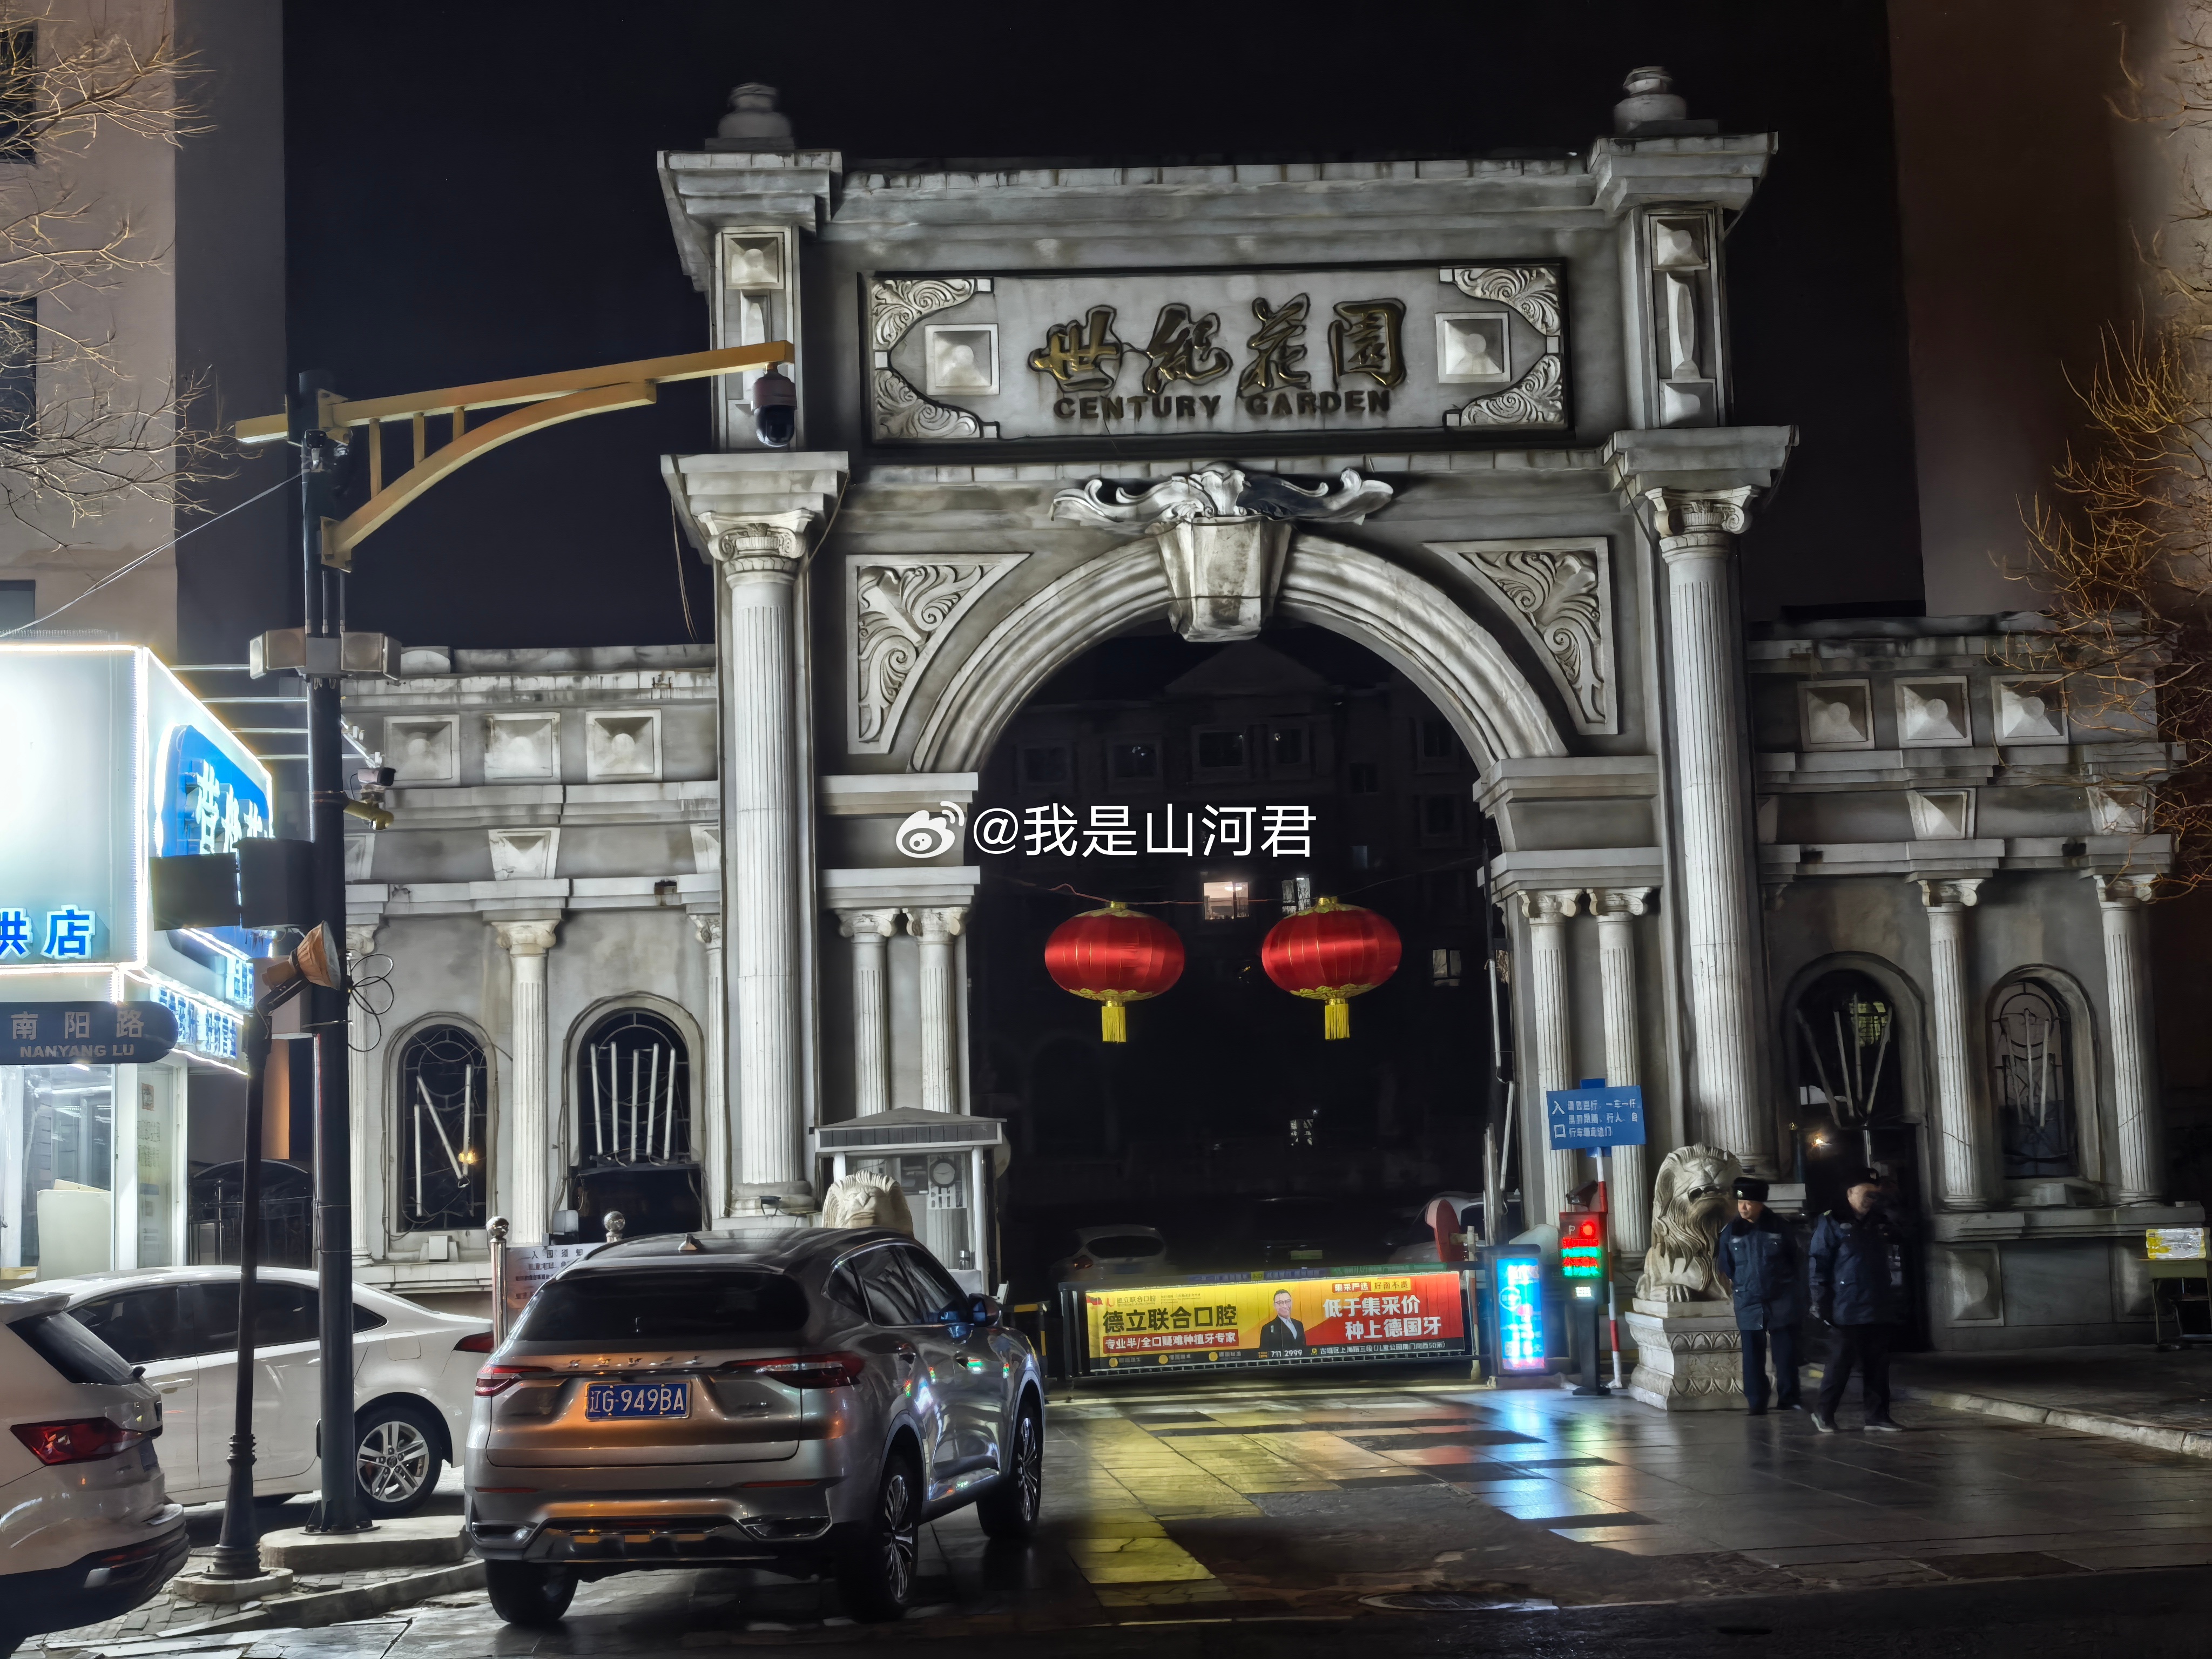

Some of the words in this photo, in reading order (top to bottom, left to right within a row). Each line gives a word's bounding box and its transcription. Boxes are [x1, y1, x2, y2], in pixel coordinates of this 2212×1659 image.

[1028, 293, 1407, 394] 世纪花园
[1053, 395, 1221, 419] CENTURY
[1246, 390, 1391, 415] GARDEN
[11, 1011, 144, 1040] 南阳路
[20, 1044, 106, 1058] NANYANG
[112, 1044, 134, 1056] LU
[1552, 1100, 1566, 1138] 入口
[1102, 1304, 1237, 1333] 德立联合口腔
[1323, 1294, 1420, 1318] 低于集采价
[1345, 1316, 1442, 1340] 种上德国牙
